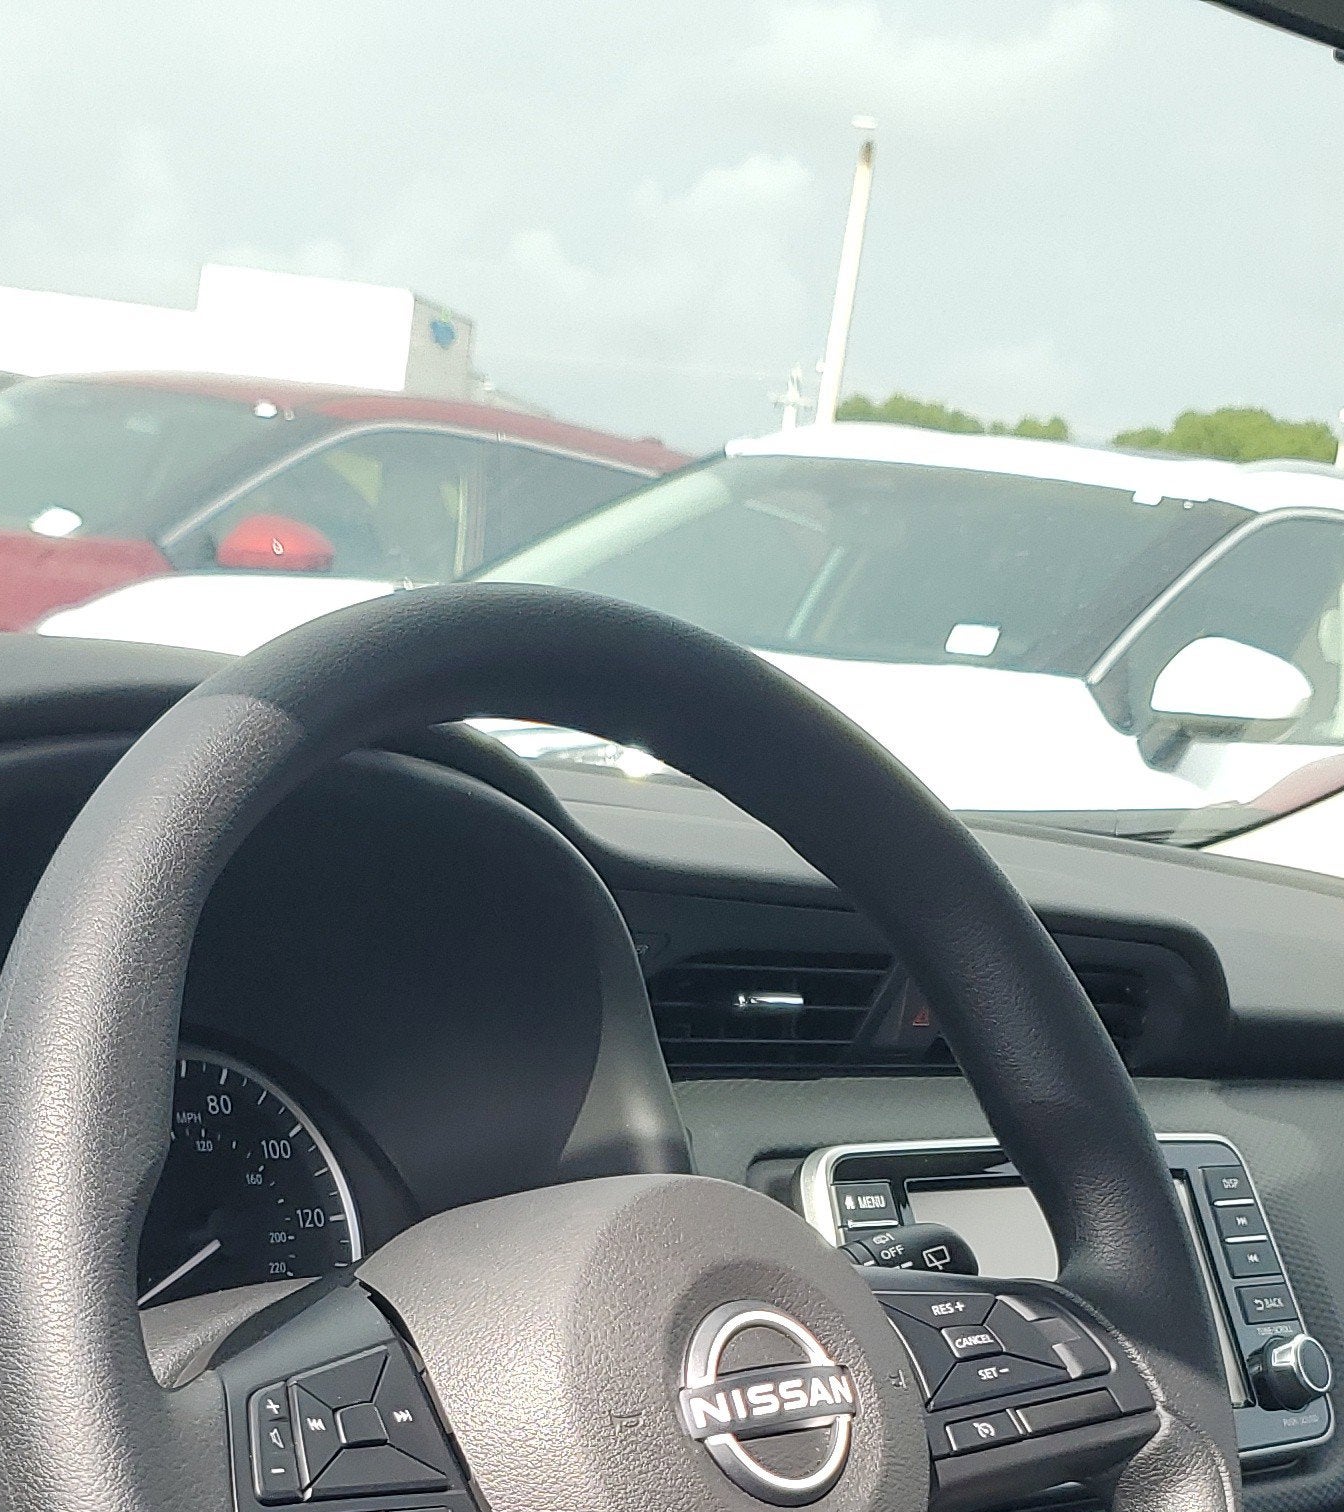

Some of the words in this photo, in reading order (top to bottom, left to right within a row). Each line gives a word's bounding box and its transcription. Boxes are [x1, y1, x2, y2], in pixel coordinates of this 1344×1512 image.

[206, 1094, 233, 1115] 80
[175, 1112, 202, 1125] MPH
[196, 1140, 213, 1152] 120
[260, 1139, 292, 1160] 100
[245, 1173, 263, 1186] 160
[857, 1195, 886, 1209] MENU
[296, 1208, 325, 1229] 120
[269, 1232, 287, 1243] 200
[880, 1244, 905, 1260] OFF
[268, 1262, 287, 1274] 220
[955, 1333, 994, 1349] CANCEL
[689, 1375, 854, 1428] NISSAN
